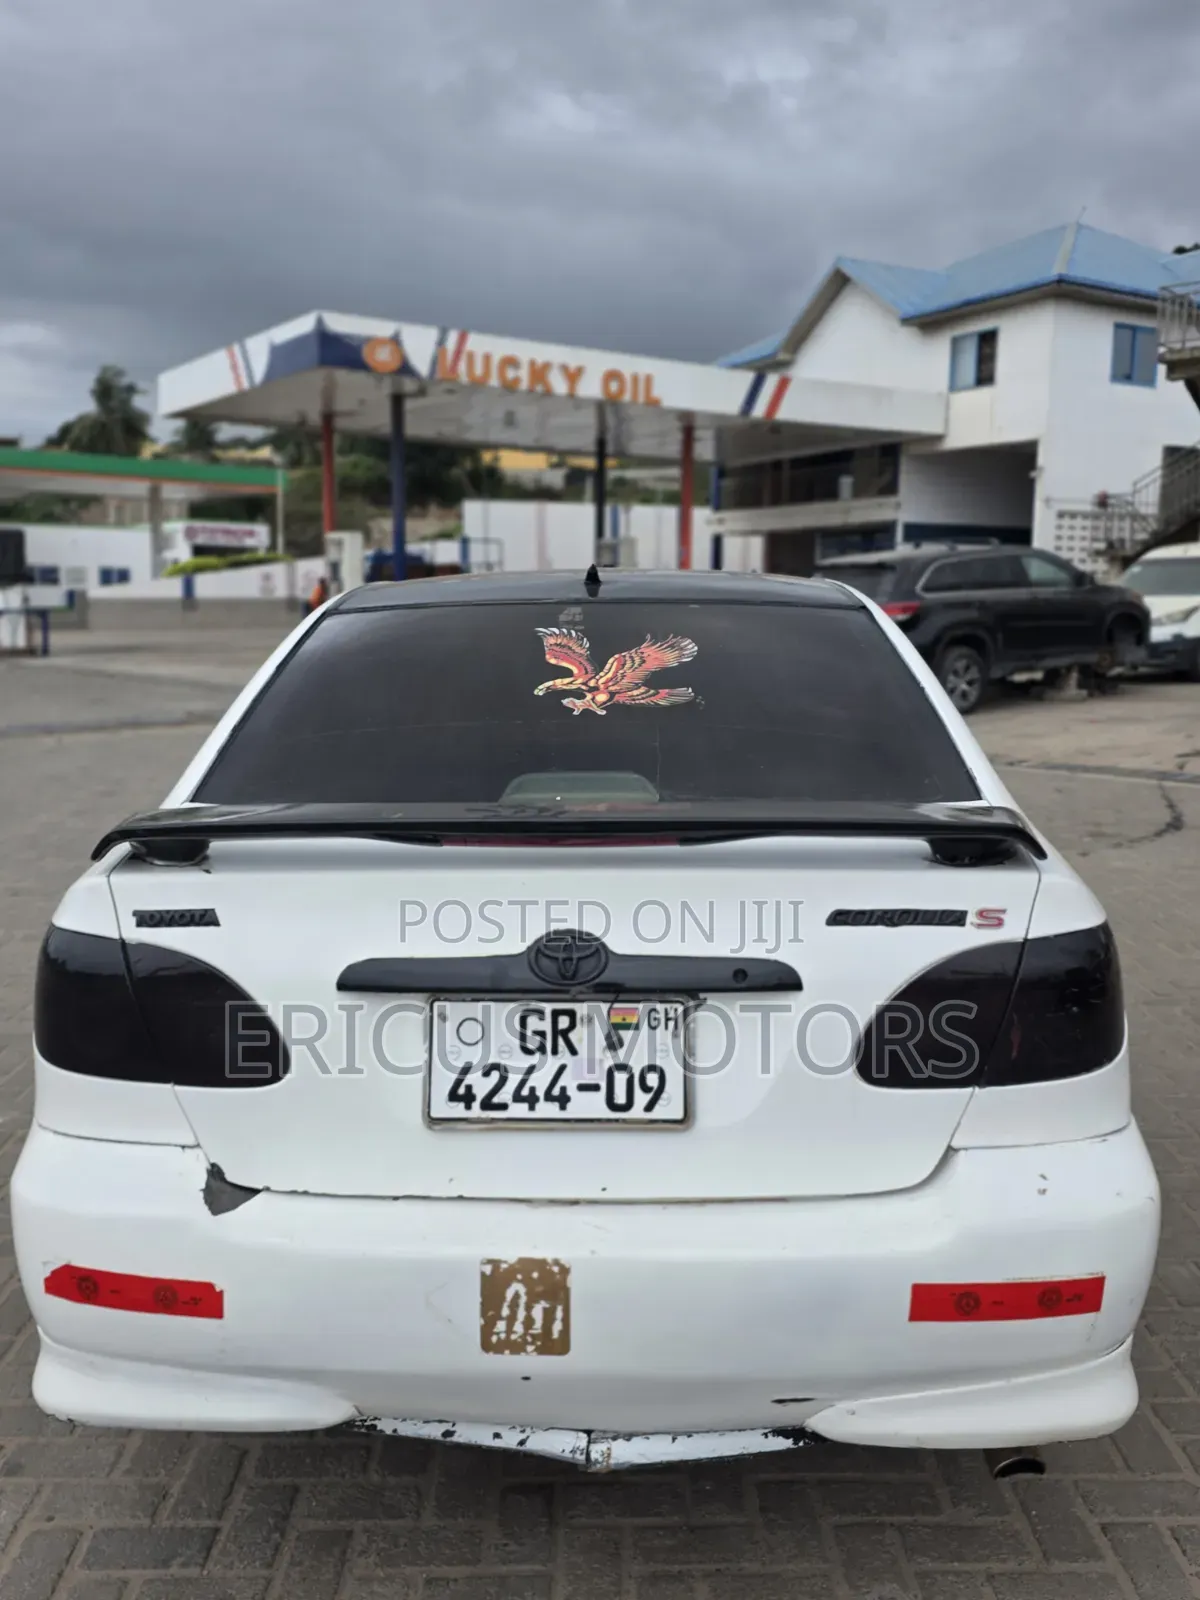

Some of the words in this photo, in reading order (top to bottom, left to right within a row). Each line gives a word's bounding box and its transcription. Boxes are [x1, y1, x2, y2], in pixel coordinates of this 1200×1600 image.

[436, 344, 586, 397] LUCKY
[602, 368, 662, 407] OIL
[132, 908, 220, 928] TOYOTA
[971, 908, 1006, 930] S
[519, 1007, 579, 1057] GR
[647, 1007, 680, 1032] GH
[447, 1061, 668, 1113] 4244-09
